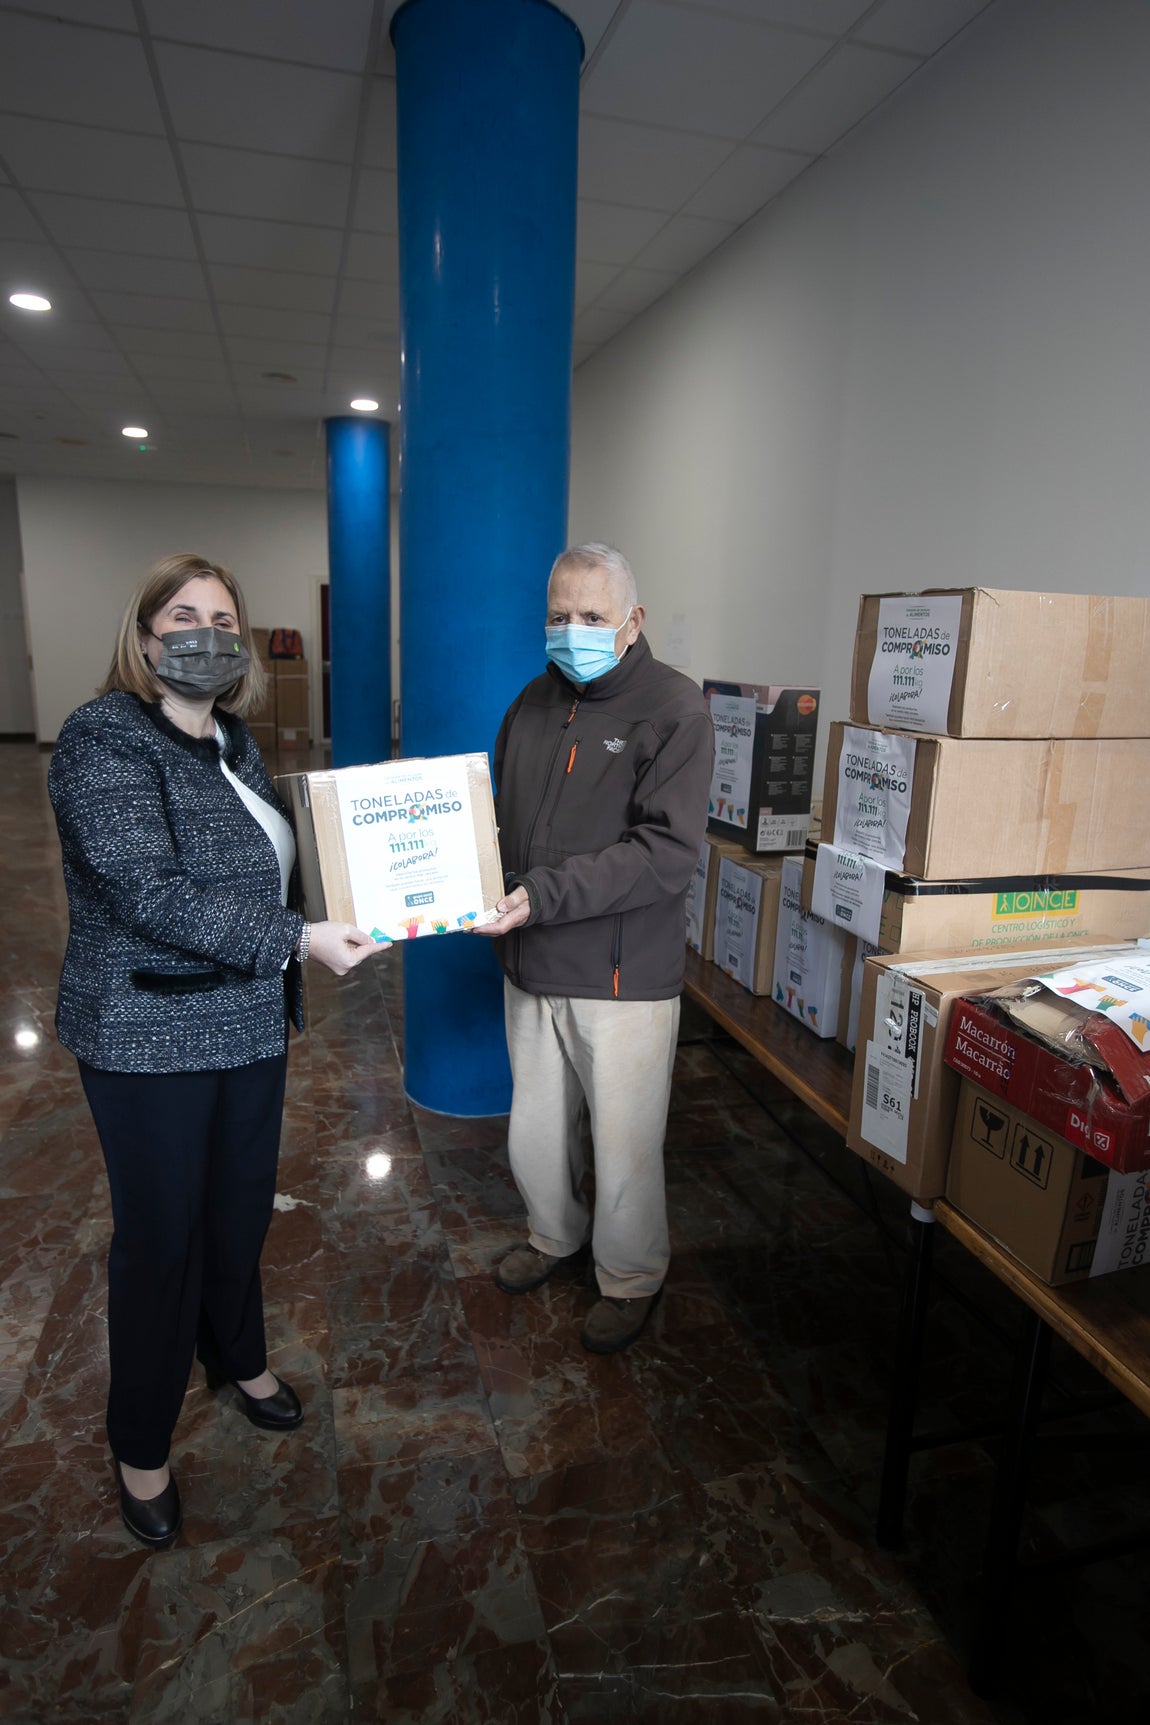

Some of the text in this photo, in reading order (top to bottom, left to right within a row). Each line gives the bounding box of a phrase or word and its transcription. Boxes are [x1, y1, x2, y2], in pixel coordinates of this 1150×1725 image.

[883, 627, 951, 641] TONELADAS de
[881, 641, 951, 657] COMPROMISO
[893, 664, 924, 676] A por los
[893, 675, 915, 686] 111.111
[713, 713, 746, 727] TONELADAS
[846, 753, 908, 779] TONELADAS de
[844, 767, 907, 793] COMPROMISO
[350, 788, 458, 812] TONELADAS de
[352, 801, 462, 826] COMPROMISO
[858, 802, 878, 816] 111.111
[388, 828, 435, 843] A por los
[389, 839, 425, 853] 111.111
[836, 853, 857, 870] 111.111
[413, 894, 434, 905] ONCE
[1015, 890, 1075, 910] ONCE
[991, 918, 1076, 934] CENTRO LOGÍSTICO Y
[972, 938, 983, 947] DE
[985, 934, 1041, 946] PRODUCCIÓN
[911, 991, 921, 1006] HP
[907, 1009, 919, 1052] PROBOOK
[959, 1015, 1017, 1060] Macarrón
[955, 1036, 1011, 1080] Macarrão
[882, 1093, 902, 1112] S61
[1118, 1171, 1149, 1269] TONELADA
